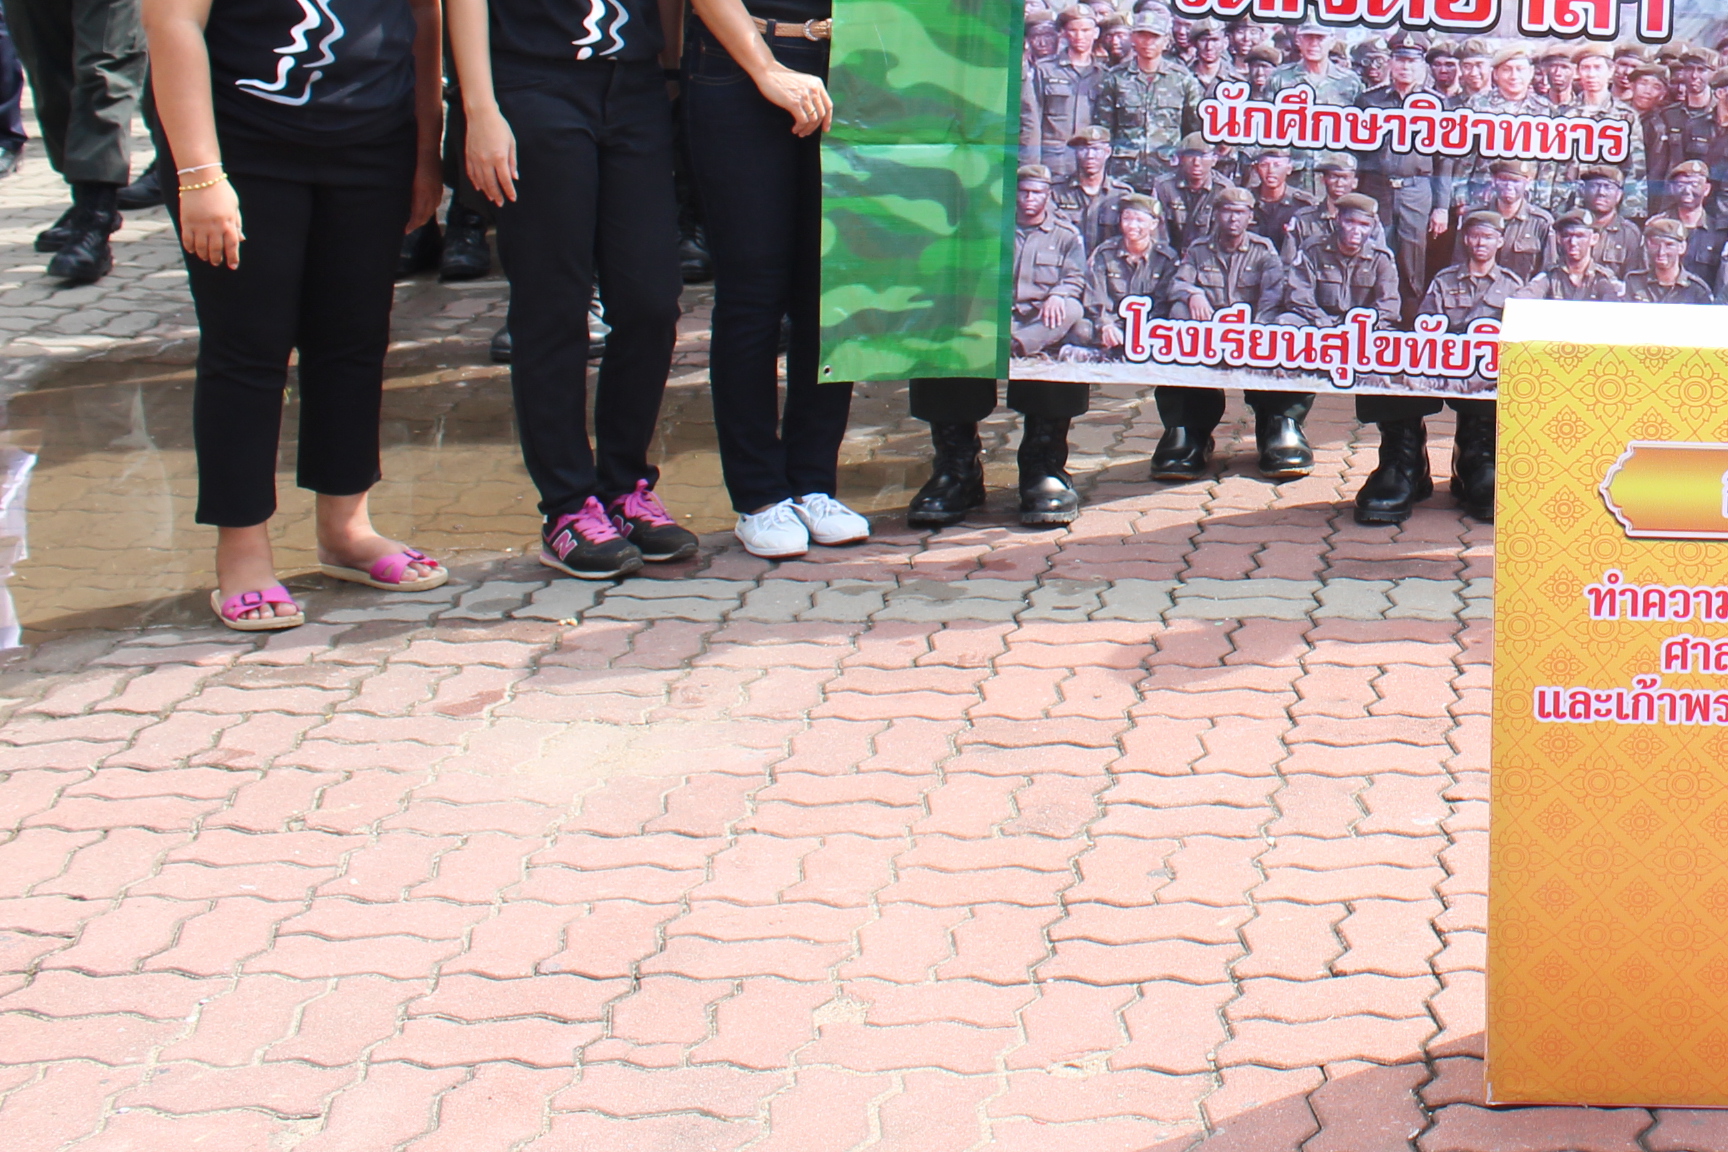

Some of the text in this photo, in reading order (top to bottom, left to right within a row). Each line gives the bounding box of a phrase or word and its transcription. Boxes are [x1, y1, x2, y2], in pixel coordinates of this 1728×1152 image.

[1202, 86, 1629, 158] นักศึกษาวิชาทหาร
